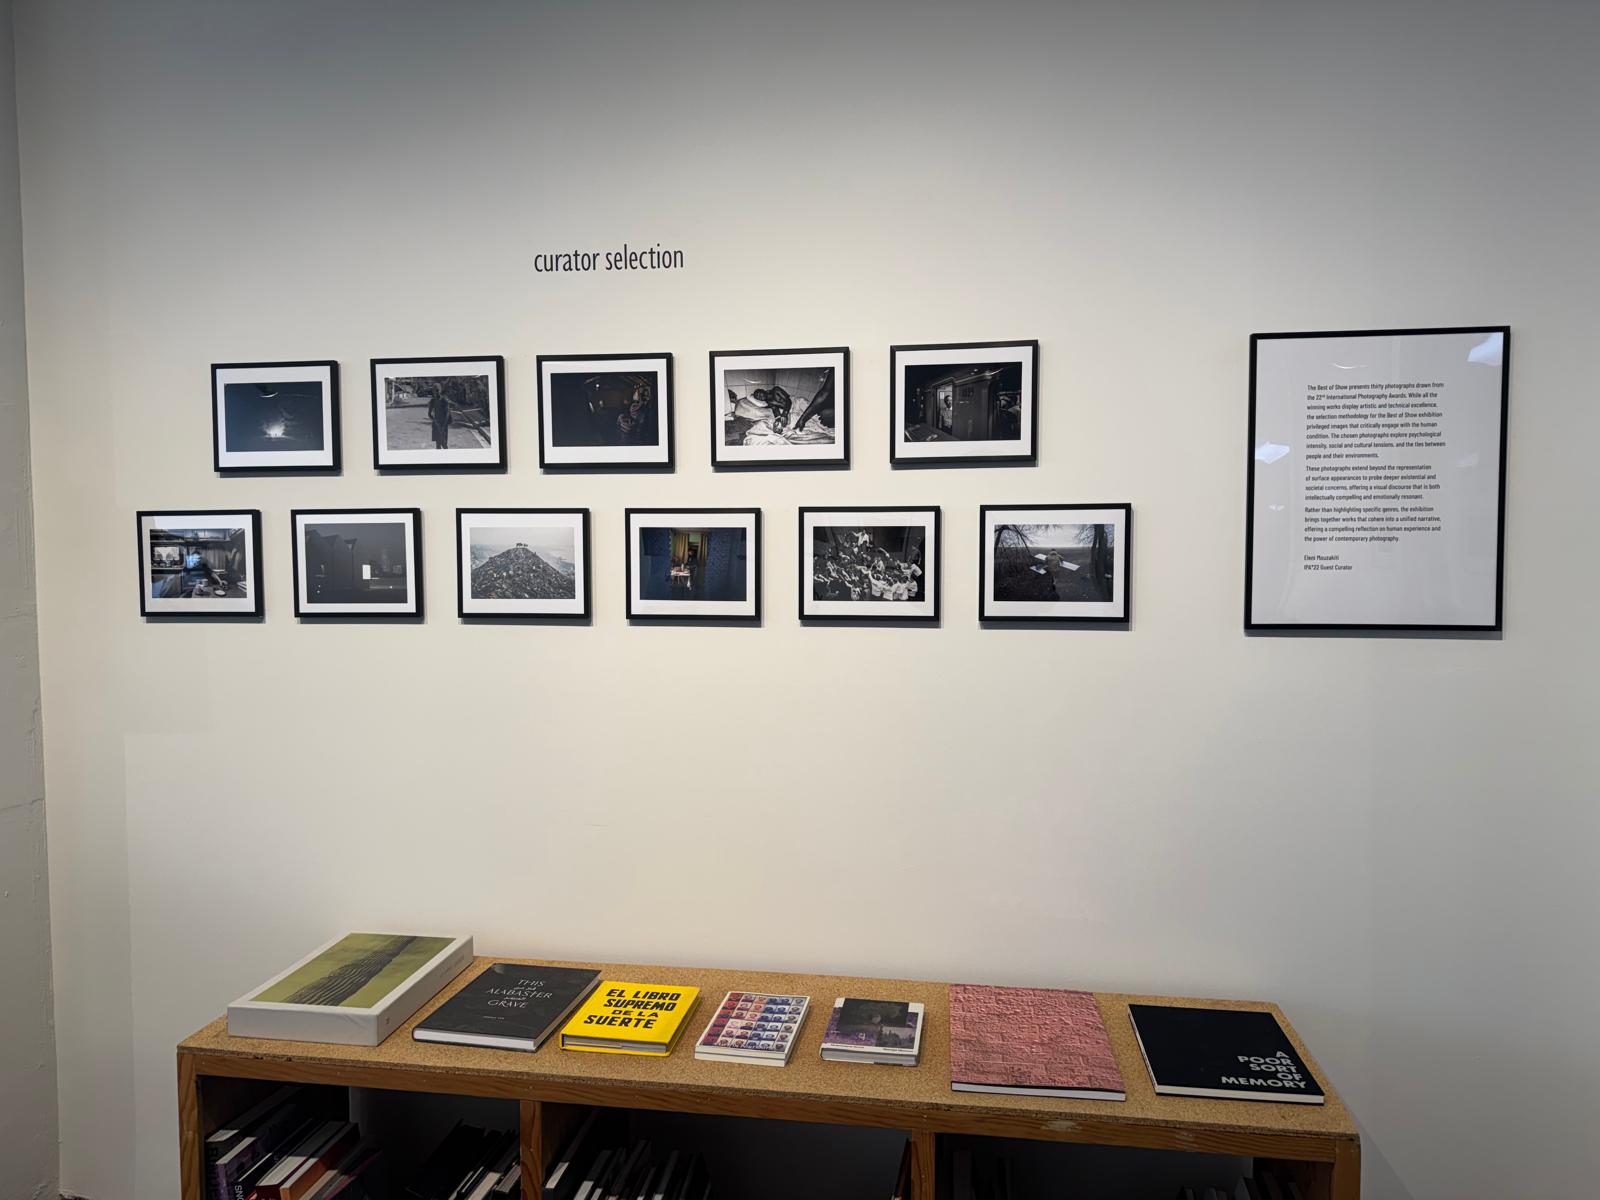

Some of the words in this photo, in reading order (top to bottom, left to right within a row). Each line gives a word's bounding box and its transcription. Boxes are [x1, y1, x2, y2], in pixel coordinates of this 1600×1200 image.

[534, 250, 600, 272] curator
[605, 243, 684, 271] selection
[1328, 383, 1333, 391] of
[1348, 383, 1369, 391] presents
[1370, 382, 1383, 391] thirty
[1384, 382, 1414, 391] photographs
[1415, 381, 1431, 389] drawn
[1357, 392, 1387, 401] Photography
[1307, 404, 1325, 412] winning
[1342, 403, 1358, 411] display
[1360, 402, 1376, 410] artistic
[1338, 412, 1368, 421] methodology
[1398, 411, 1403, 419] of
[1306, 422, 1329, 431] privileged
[1330, 423, 1347, 431] images
[1360, 422, 1380, 430] critically
[1306, 432, 1329, 440] condition.
[1358, 431, 1389, 440] photographs
[1389, 431, 1407, 440] explore
[1408, 431, 1441, 439] psychological
[1354, 441, 1372, 449] cultural
[1373, 441, 1394, 450] tensions,
[1424, 440, 1446, 448] between
[1305, 452, 1321, 461] people
[1320, 464, 1350, 473] photographs
[1369, 464, 1386, 473] beyond
[1396, 464, 1431, 472] representation
[1311, 474, 1329, 482] surface
[1330, 475, 1361, 483] appearances
[1368, 474, 1382, 482] probe
[1383, 474, 1399, 482] deeper
[1400, 473, 1426, 481] existential
[1349, 484, 1368, 492] offering
[1305, 494, 1334, 502] intellectually
[1336, 493, 1362, 502] compelling
[1372, 493, 1400, 502] emotionally
[1333, 506, 1361, 514] highlighting
[1362, 506, 1381, 514] specific
[1304, 516, 1319, 524] brings
[1320, 516, 1340, 524] together
[1384, 515, 1394, 523] into
[1304, 525, 1323, 534] offering
[1328, 525, 1354, 534] compelling
[1403, 526, 1430, 534] experience
[1334, 535, 1367, 543] contemporary
[1368, 535, 1399, 543] photography.
[1334, 563, 1352, 571] Curator
[518, 979, 545, 987] THIS
[606, 988, 627, 998] EL
[632, 990, 682, 1001] LIBRO
[603, 998, 677, 1011] SUPREMO
[637, 1010, 659, 1018] LA
[583, 1014, 657, 1029] SUERTE
[1276, 1050, 1290, 1058] A
[1237, 1055, 1294, 1066] POOR
[1249, 1063, 1297, 1073] SORT
[1276, 1072, 1303, 1081] OF
[1221, 1076, 1307, 1089] MEMORY
